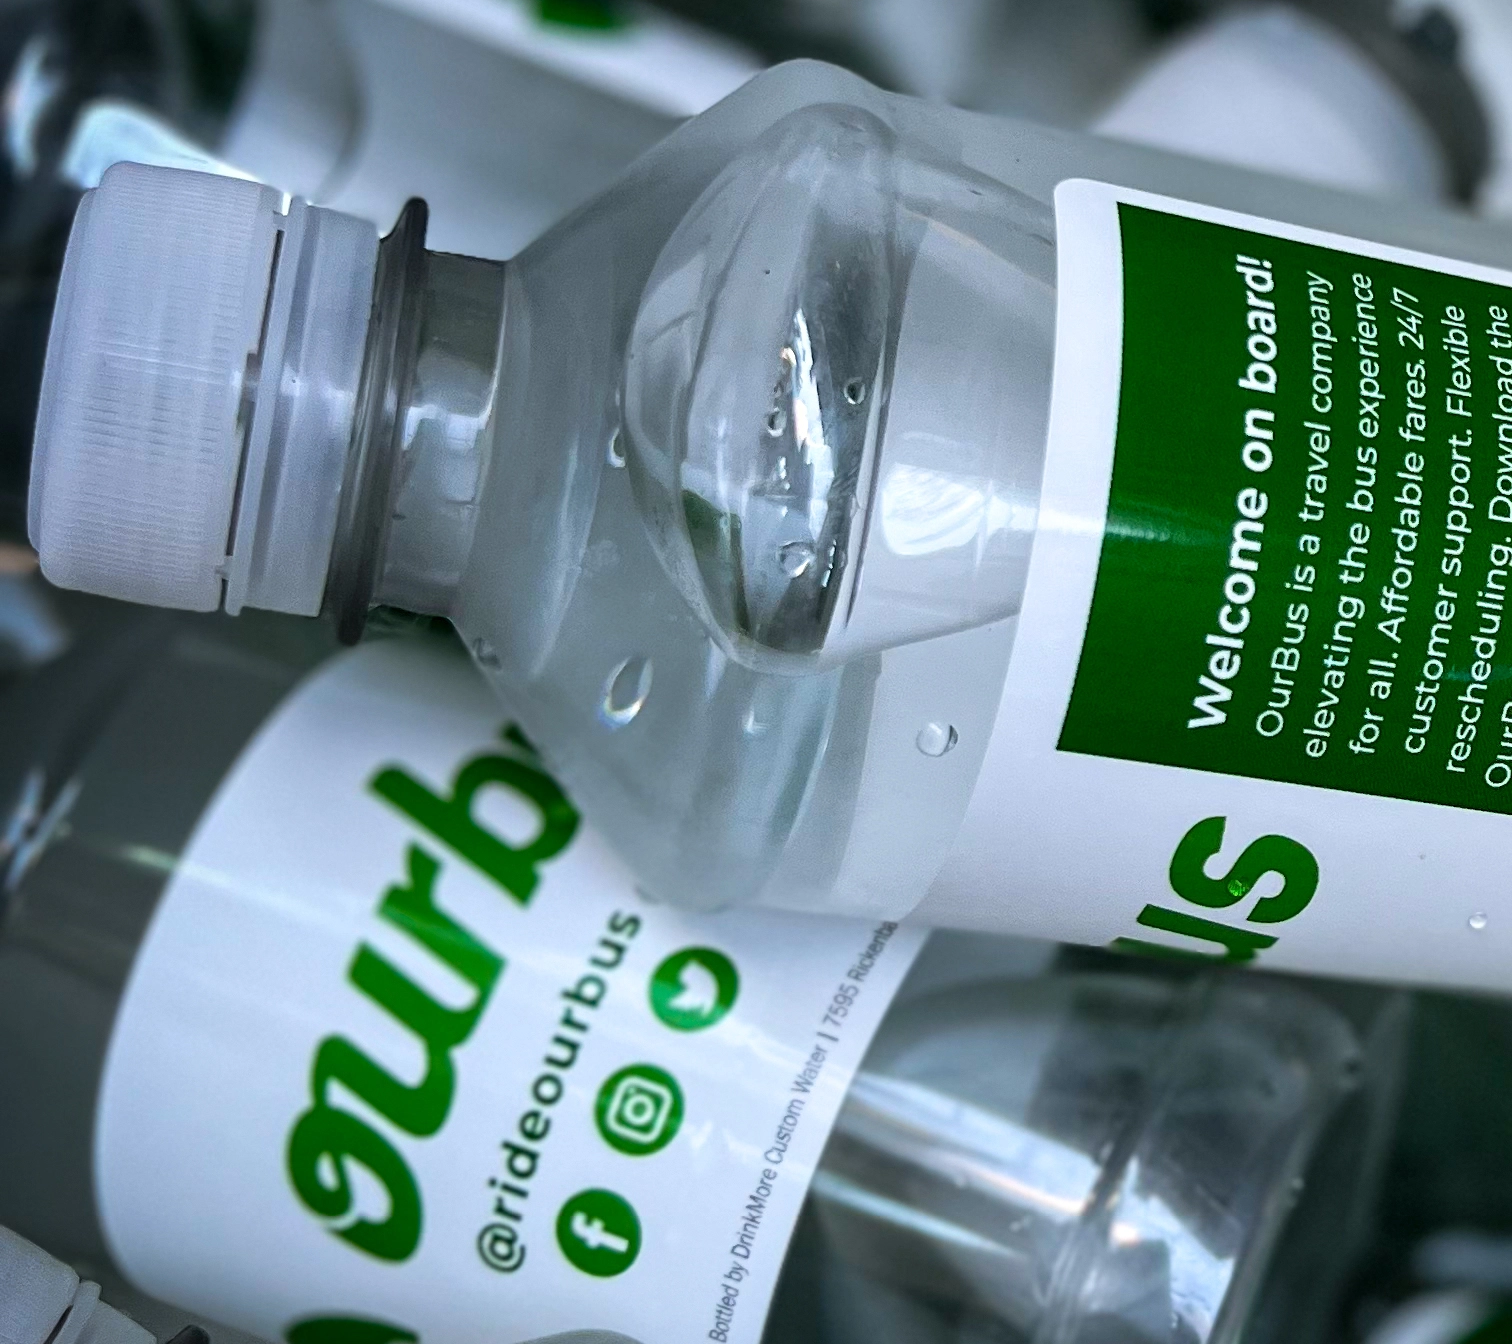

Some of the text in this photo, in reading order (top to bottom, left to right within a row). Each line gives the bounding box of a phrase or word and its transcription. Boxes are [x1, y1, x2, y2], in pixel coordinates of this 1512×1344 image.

[1486, 306, 1509, 348] the
[1187, 254, 1278, 729] Welcome on board!
[1256, 270, 1338, 737] OurBus is a travel company
[1304, 272, 1386, 757] elevating the bus experience
[1349, 287, 1427, 754] for all. Affordable fares. 24/7
[1405, 306, 1474, 753] customer support. Flexible
[285, 719, 583, 1267] ourb
[477, 909, 643, 1274] @rideourbus
[791, 1044, 827, 1093] Water
[823, 984, 859, 1028] 7595
[732, 1169, 778, 1259] DrinkMore
[764, 1098, 805, 1164] Custom
[709, 1284, 739, 1343] Bottled
[724, 1261, 749, 1282] by
